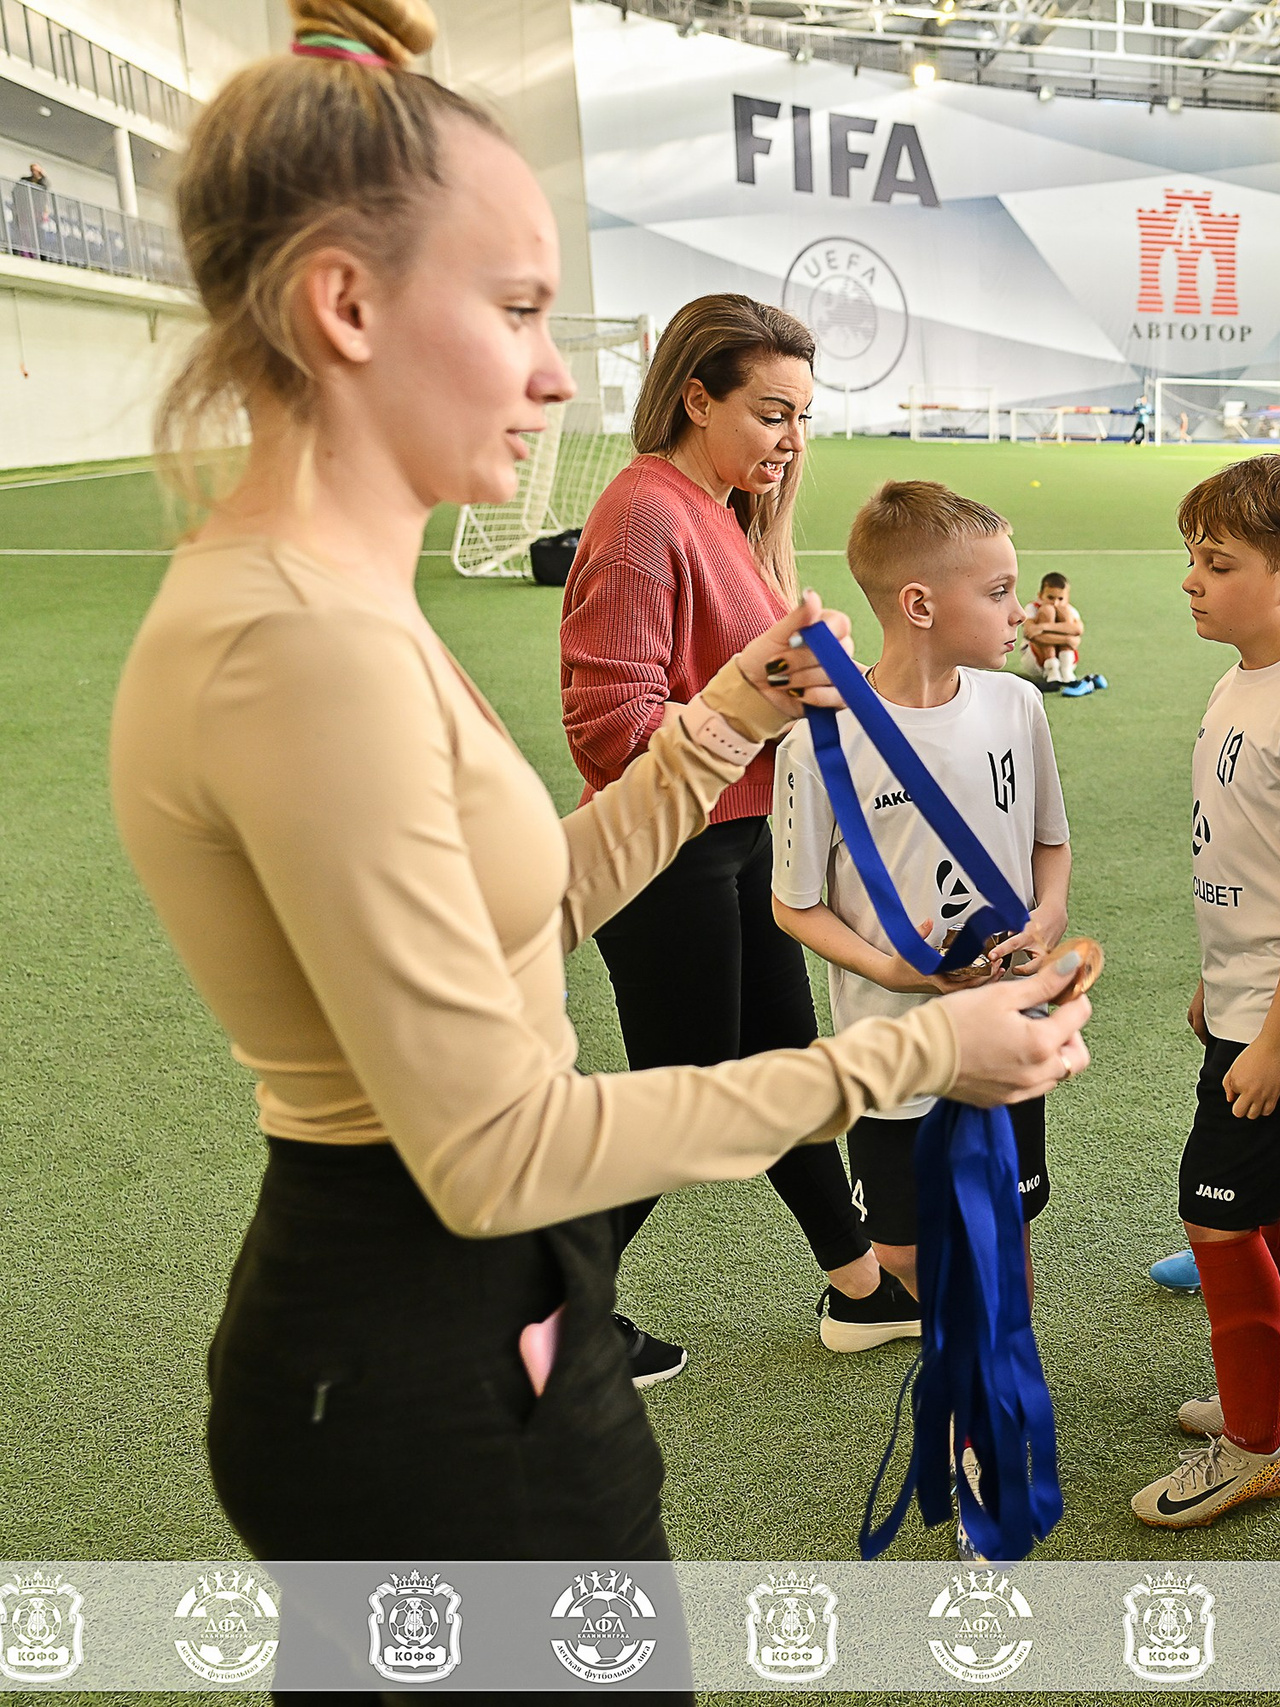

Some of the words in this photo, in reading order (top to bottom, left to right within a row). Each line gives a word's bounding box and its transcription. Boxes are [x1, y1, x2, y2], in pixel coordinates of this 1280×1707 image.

[732, 93, 942, 208] FIFA
[803, 250, 876, 285] UEFA
[1129, 321, 1254, 343] АВТОТОР
[1196, 1183, 1236, 1203] JAKO
